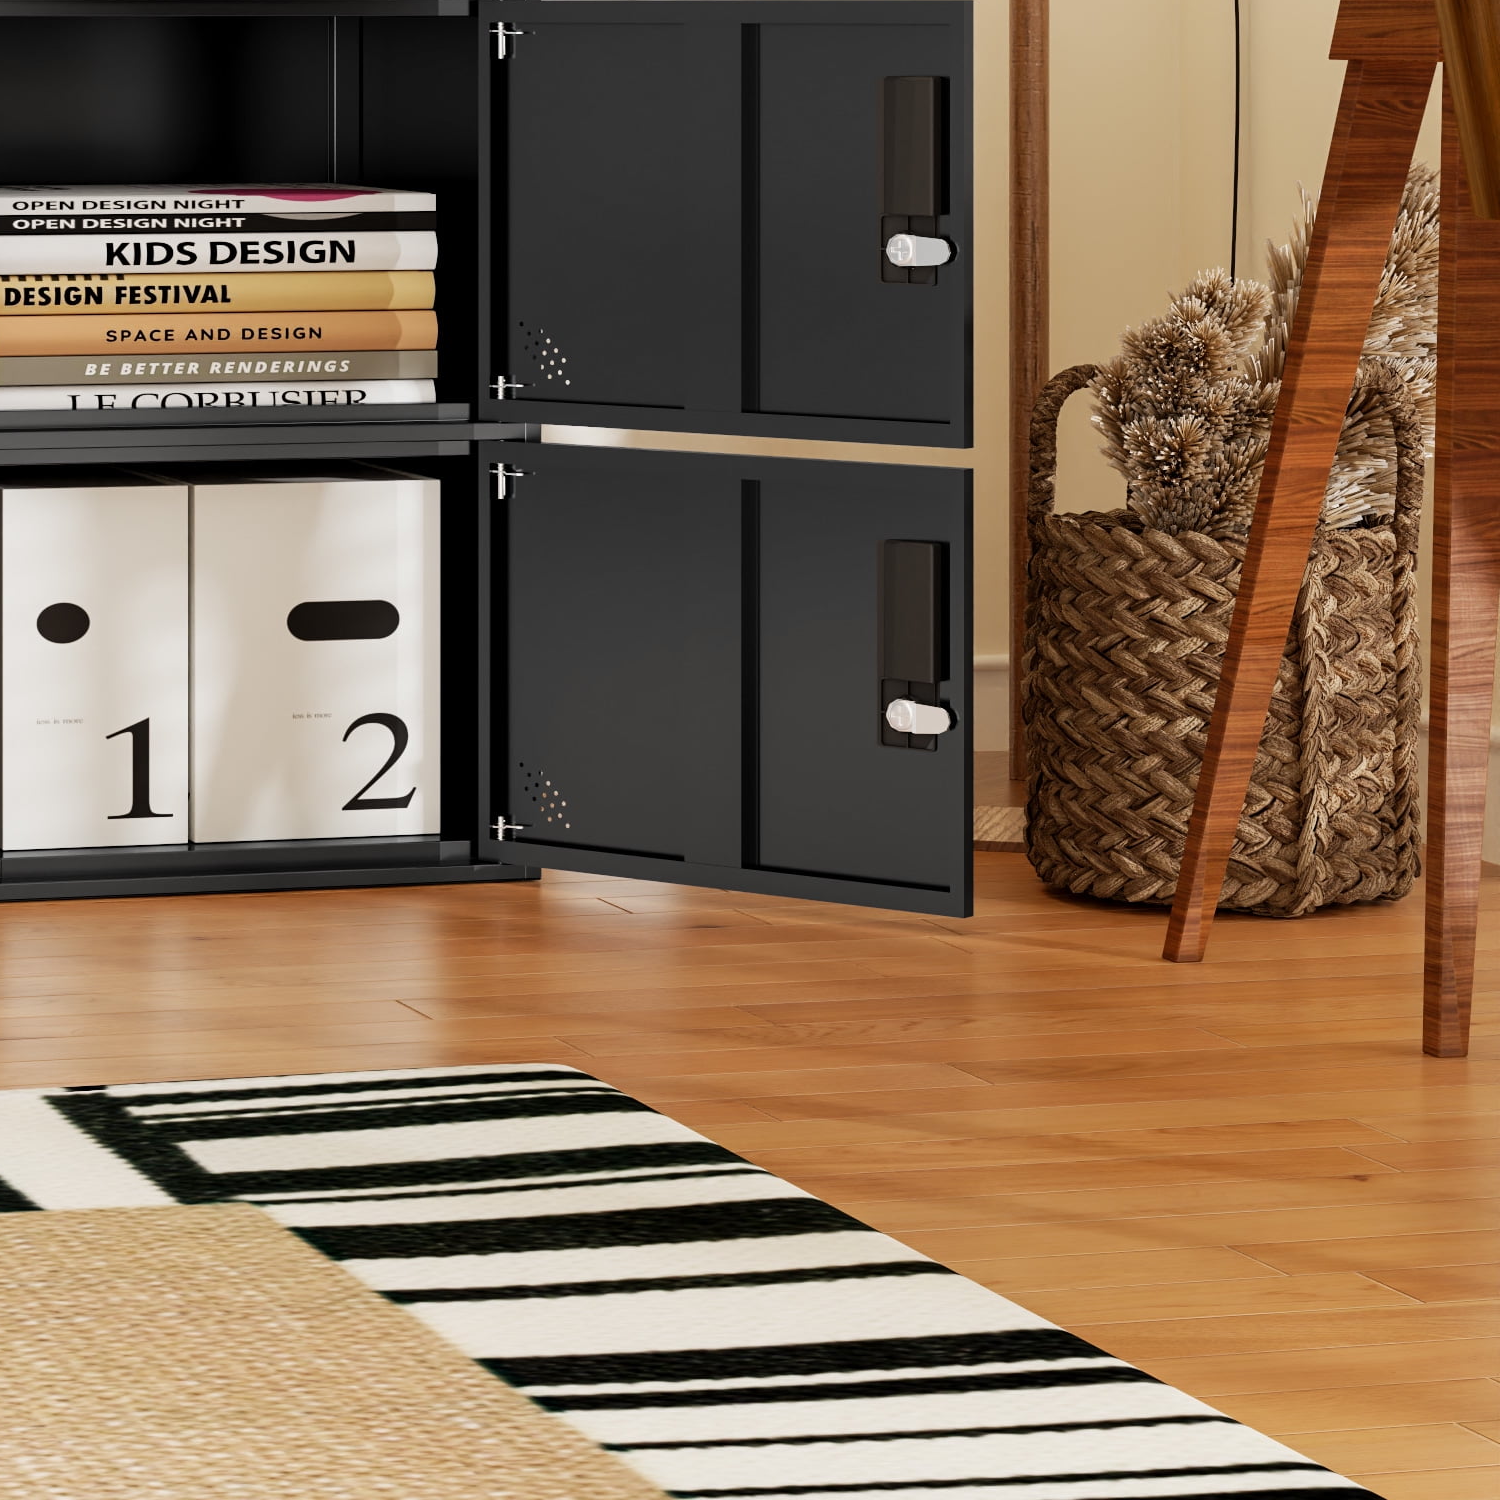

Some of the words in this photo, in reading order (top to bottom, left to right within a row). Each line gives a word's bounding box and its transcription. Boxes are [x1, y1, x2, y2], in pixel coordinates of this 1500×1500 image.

[12, 200, 75, 211] OPEN
[82, 200, 166, 210] DESIGN
[174, 199, 246, 210] NIGHT
[12, 218, 76, 230] OPEN
[82, 218, 168, 229] DESIGN
[174, 217, 247, 229] NIGHT
[105, 241, 198, 266] KIDS
[209, 239, 356, 265] DESIGN
[4, 286, 103, 307] DESIGN
[115, 284, 231, 305] FESTIVAL
[105, 329, 175, 342] SPACE
[185, 328, 231, 341] AND
[241, 327, 323, 340] DESIGN
[84, 363, 111, 376] BE
[120, 362, 200, 376] BETTER
[209, 359, 350, 375] RENDERINGS
[105, 717, 174, 820] 1
[341, 712, 417, 811] 2
